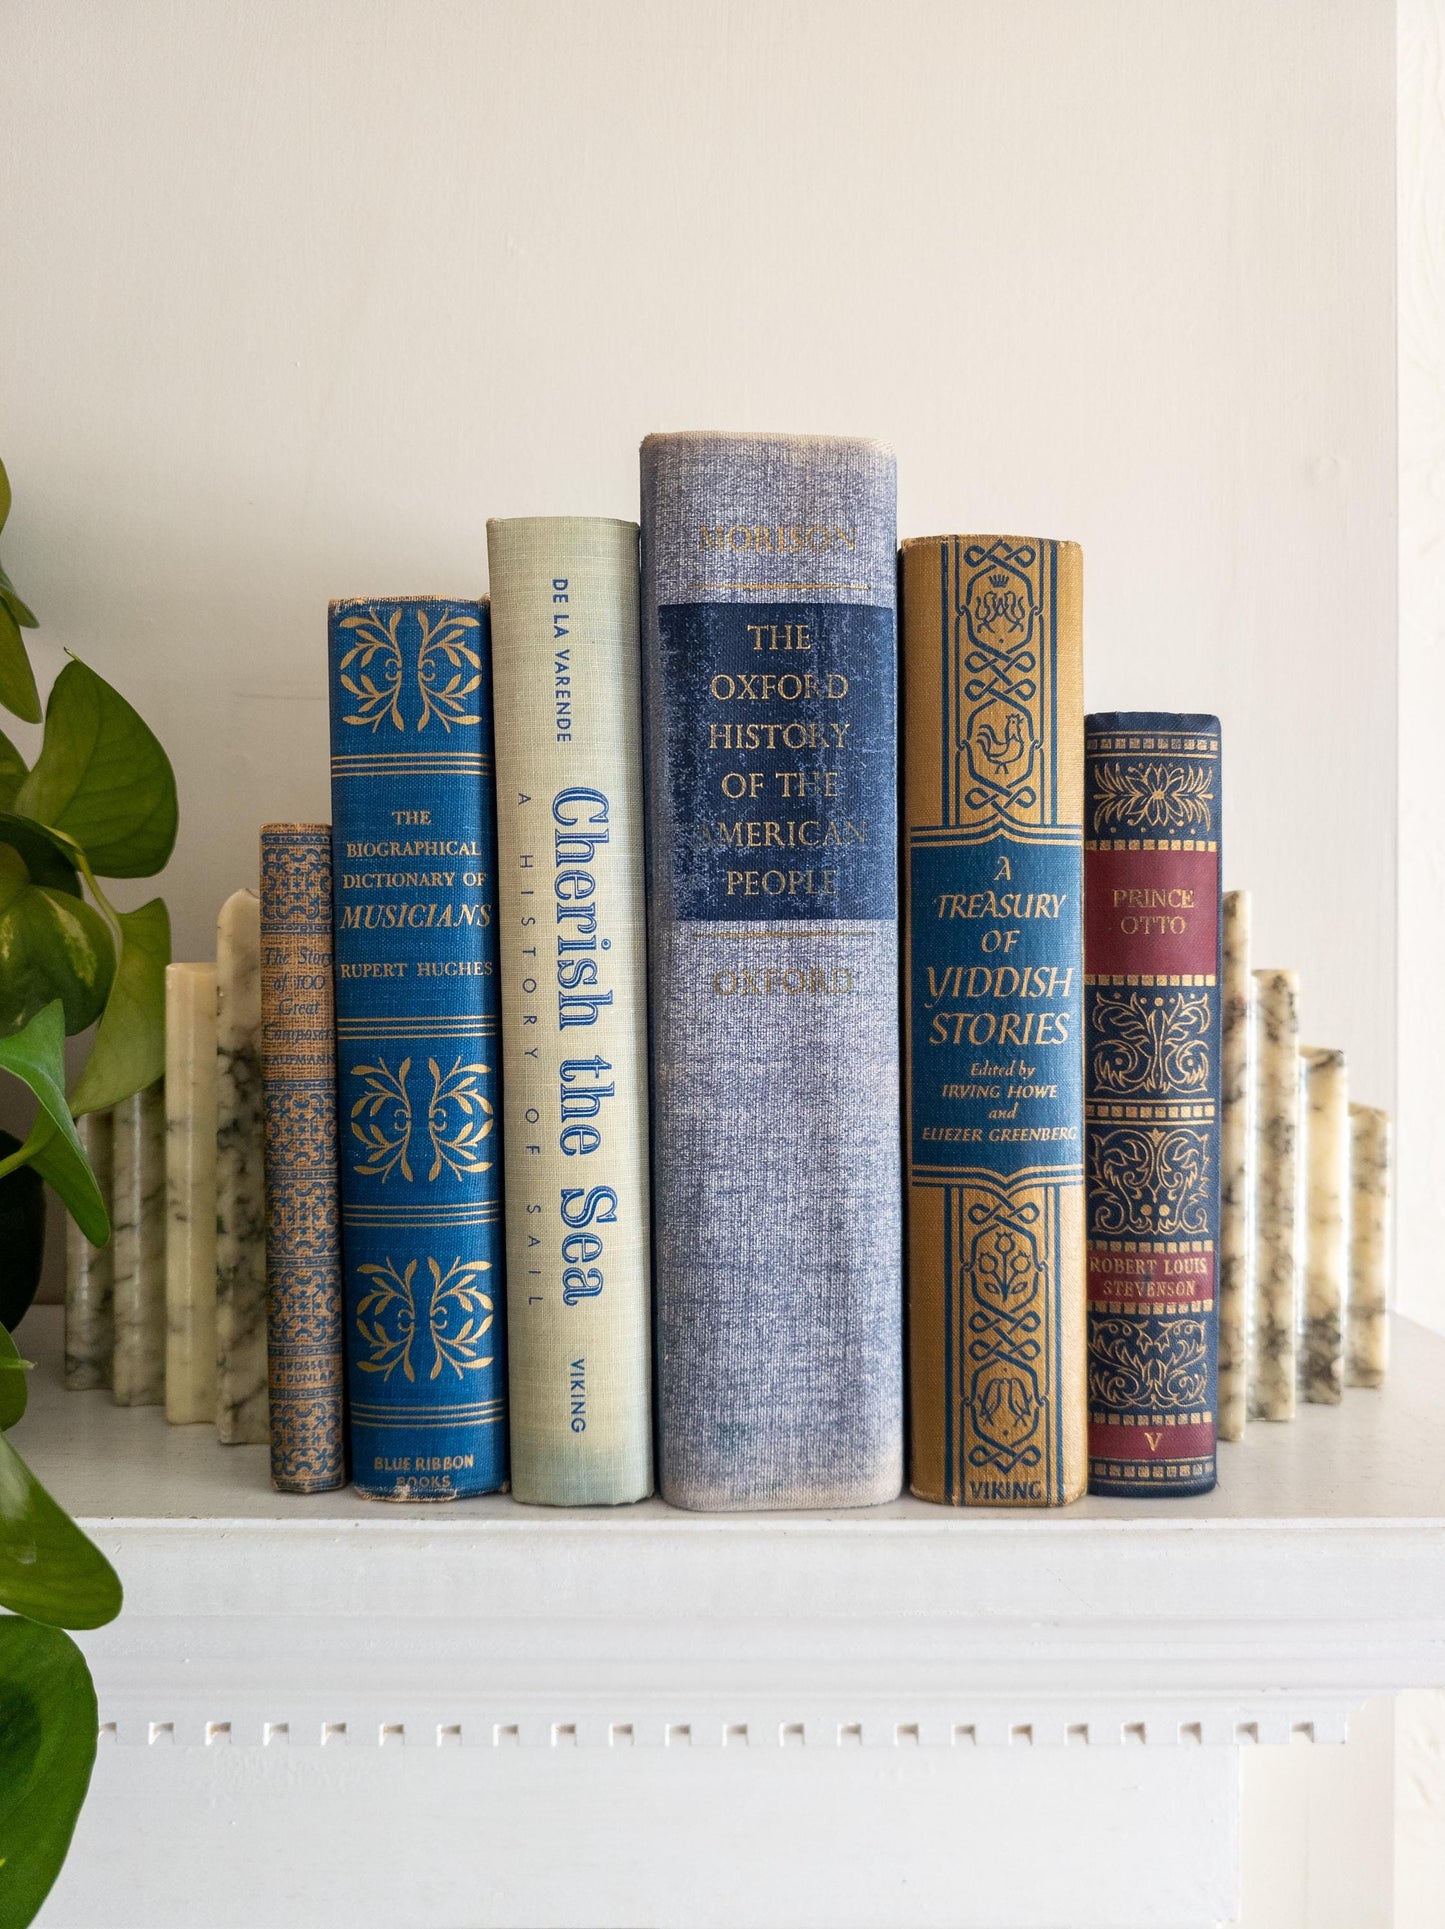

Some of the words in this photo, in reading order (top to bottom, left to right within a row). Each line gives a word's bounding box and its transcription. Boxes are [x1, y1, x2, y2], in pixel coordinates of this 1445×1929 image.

[700, 525, 856, 552] MORISON
[552, 578, 569, 604] DE
[553, 613, 570, 639] LA
[747, 624, 812, 650] THE
[554, 648, 572, 743] VARENDE
[709, 674, 849, 700] OXFORD
[709, 722, 850, 749] HISTORY
[721, 772, 764, 798] OF
[775, 772, 838, 798] THE
[518, 792, 532, 806] A
[391, 810, 432, 825] THE
[346, 841, 482, 858] BIOGRAPHICAL
[993, 855, 1012, 881] A
[343, 871, 455, 889] DICTIONARY
[463, 871, 487, 887] OF
[727, 869, 839, 896] PEOPLE
[552, 786, 614, 1031] Cherish
[933, 890, 1067, 919] TREASURY
[1112, 889, 1194, 908] PRINCE
[339, 903, 492, 929] MUSICIANS
[1120, 915, 1186, 935] OTTO
[981, 930, 1020, 953] OF
[264, 947, 291, 966] The
[520, 854, 539, 1060] HISTORY
[340, 962, 407, 979] RUPERT
[417, 961, 493, 977] HUGHES
[272, 972, 289, 993] of
[295, 974, 327, 990] 100
[712, 968, 854, 996] OXFORD
[924, 966, 1075, 1008] YIDDISH
[277, 998, 320, 1016] Great
[262, 1023, 336, 1043] Composers
[928, 1012, 1071, 1046] STORIES
[970, 1059, 1016, 1077] Edited
[1019, 1060, 1036, 1079] by
[941, 1085, 1001, 1098] IRVING
[1007, 1084, 1058, 1098] HOWE
[559, 1054, 616, 1157] the
[988, 1101, 1019, 1120] and
[525, 1107, 541, 1154] OF
[922, 1127, 983, 1141] ELIEZER
[988, 1126, 1079, 1142] GREENBERG
[527, 1204, 544, 1306] SAIL
[559, 1185, 618, 1307] Sea
[1091, 1257, 1157, 1275] ROBERT
[1163, 1257, 1208, 1275] LOUIS
[1103, 1280, 1196, 1297] STEVENSON
[286, 1370, 335, 1384] DUNLAP
[569, 1358, 586, 1433] VIKING
[1144, 1432, 1163, 1451] V
[374, 1456, 411, 1471] BLUE
[415, 1454, 474, 1471] RIBBON
[396, 1475, 452, 1488] BOOKS
[969, 1480, 1042, 1500] VIKING
